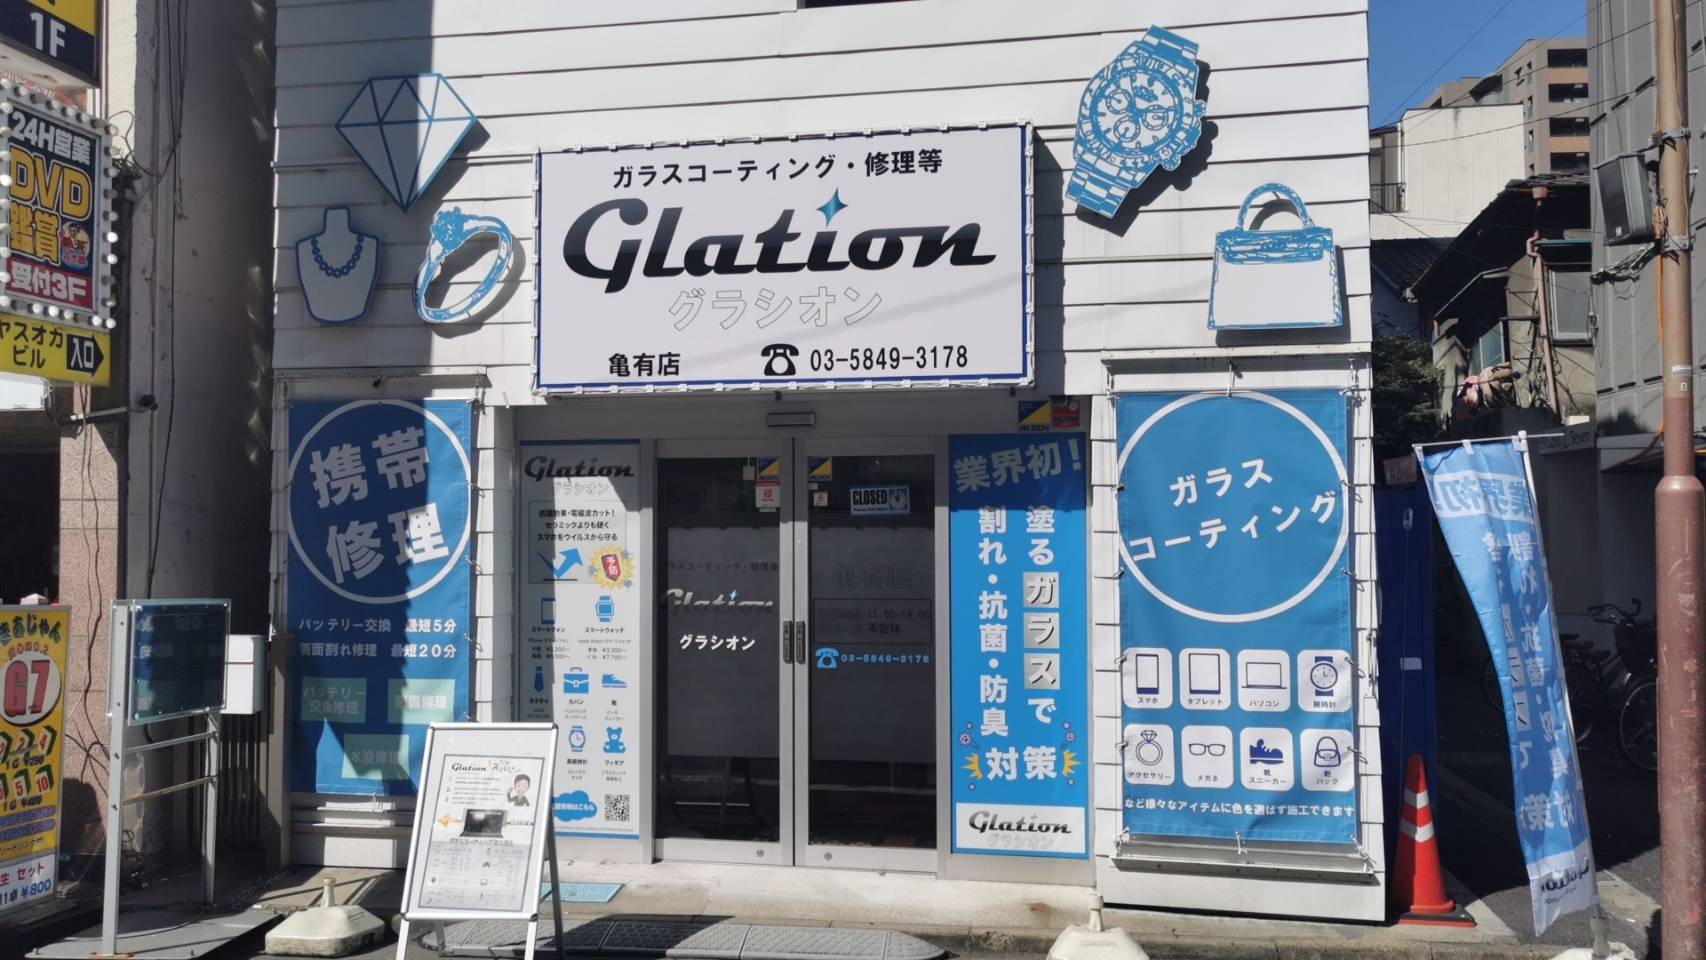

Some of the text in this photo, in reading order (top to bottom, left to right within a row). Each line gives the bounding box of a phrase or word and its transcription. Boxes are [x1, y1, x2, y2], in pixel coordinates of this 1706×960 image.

[30, 12, 66, 57] 1F
[11, 110, 91, 166] 24H営業
[9, 147, 93, 220] DVD
[612, 148, 943, 189] ガラスコーティング・修理等
[9, 202, 61, 266] 鑑賞
[562, 195, 997, 294] Glation
[11, 260, 88, 302] 受付3F
[668, 286, 883, 332] グラシオン
[12, 345, 46, 369] ビル
[70, 337, 95, 369] 入口
[608, 351, 682, 377] 亀有店
[809, 345, 968, 372] 03-5849-3178
[308, 426, 430, 509] 携帯
[1169, 458, 1274, 507] ガラス
[853, 489, 888, 505] CLOSED
[324, 502, 450, 585] 修理
[1129, 490, 1337, 562] コーティング
[679, 634, 756, 651] グラシオン
[1137, 696, 1159, 705] スマホ
[985, 745, 1058, 782] 対策
[968, 811, 1073, 836] Glation
[17, 862, 45, 881] セット
[21, 878, 52, 899] ¥800
